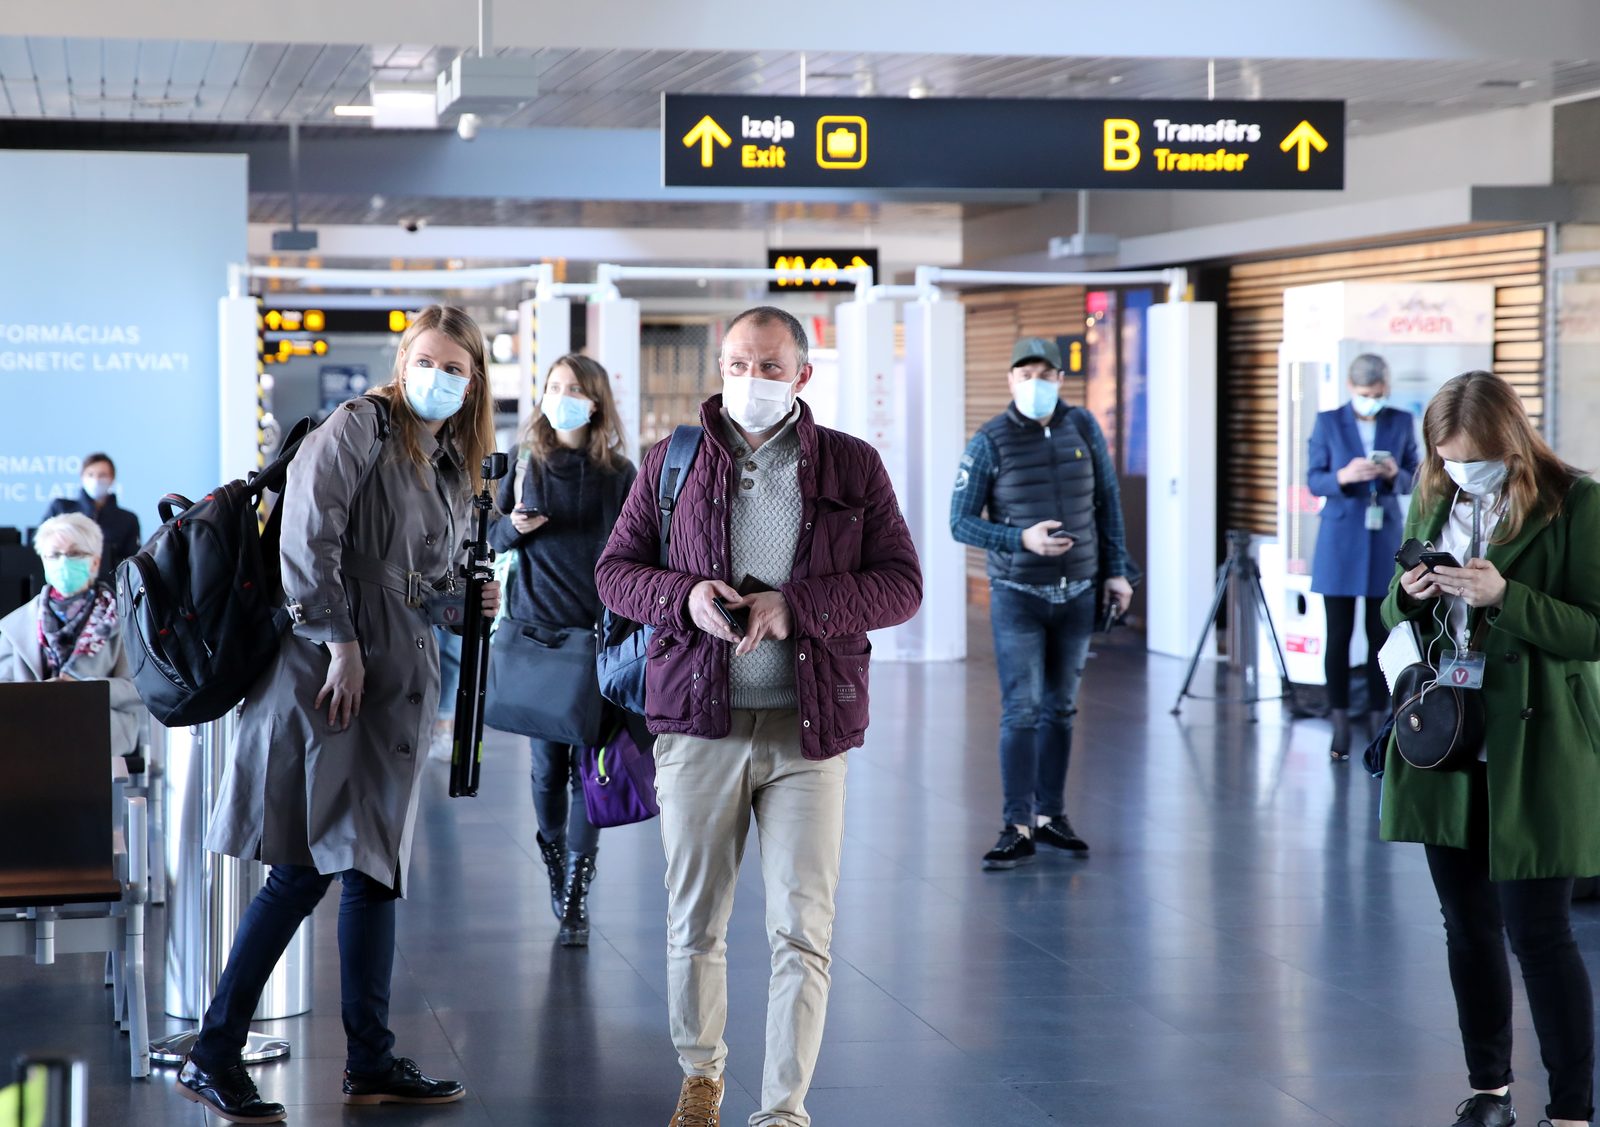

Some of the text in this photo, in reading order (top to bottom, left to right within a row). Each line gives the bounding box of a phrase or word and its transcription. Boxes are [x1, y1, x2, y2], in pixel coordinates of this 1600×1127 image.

[741, 114, 795, 143] Izeja
[1153, 119, 1261, 142] Transfērs
[1103, 118, 1141, 171] B
[741, 145, 786, 168] Exit
[1153, 148, 1249, 171] Transfer
[1389, 314, 1454, 335] evian
[0, 352, 86, 371] GNETIC
[0, 455, 83, 475] RMATIO
[1455, 671, 1466, 683] V
